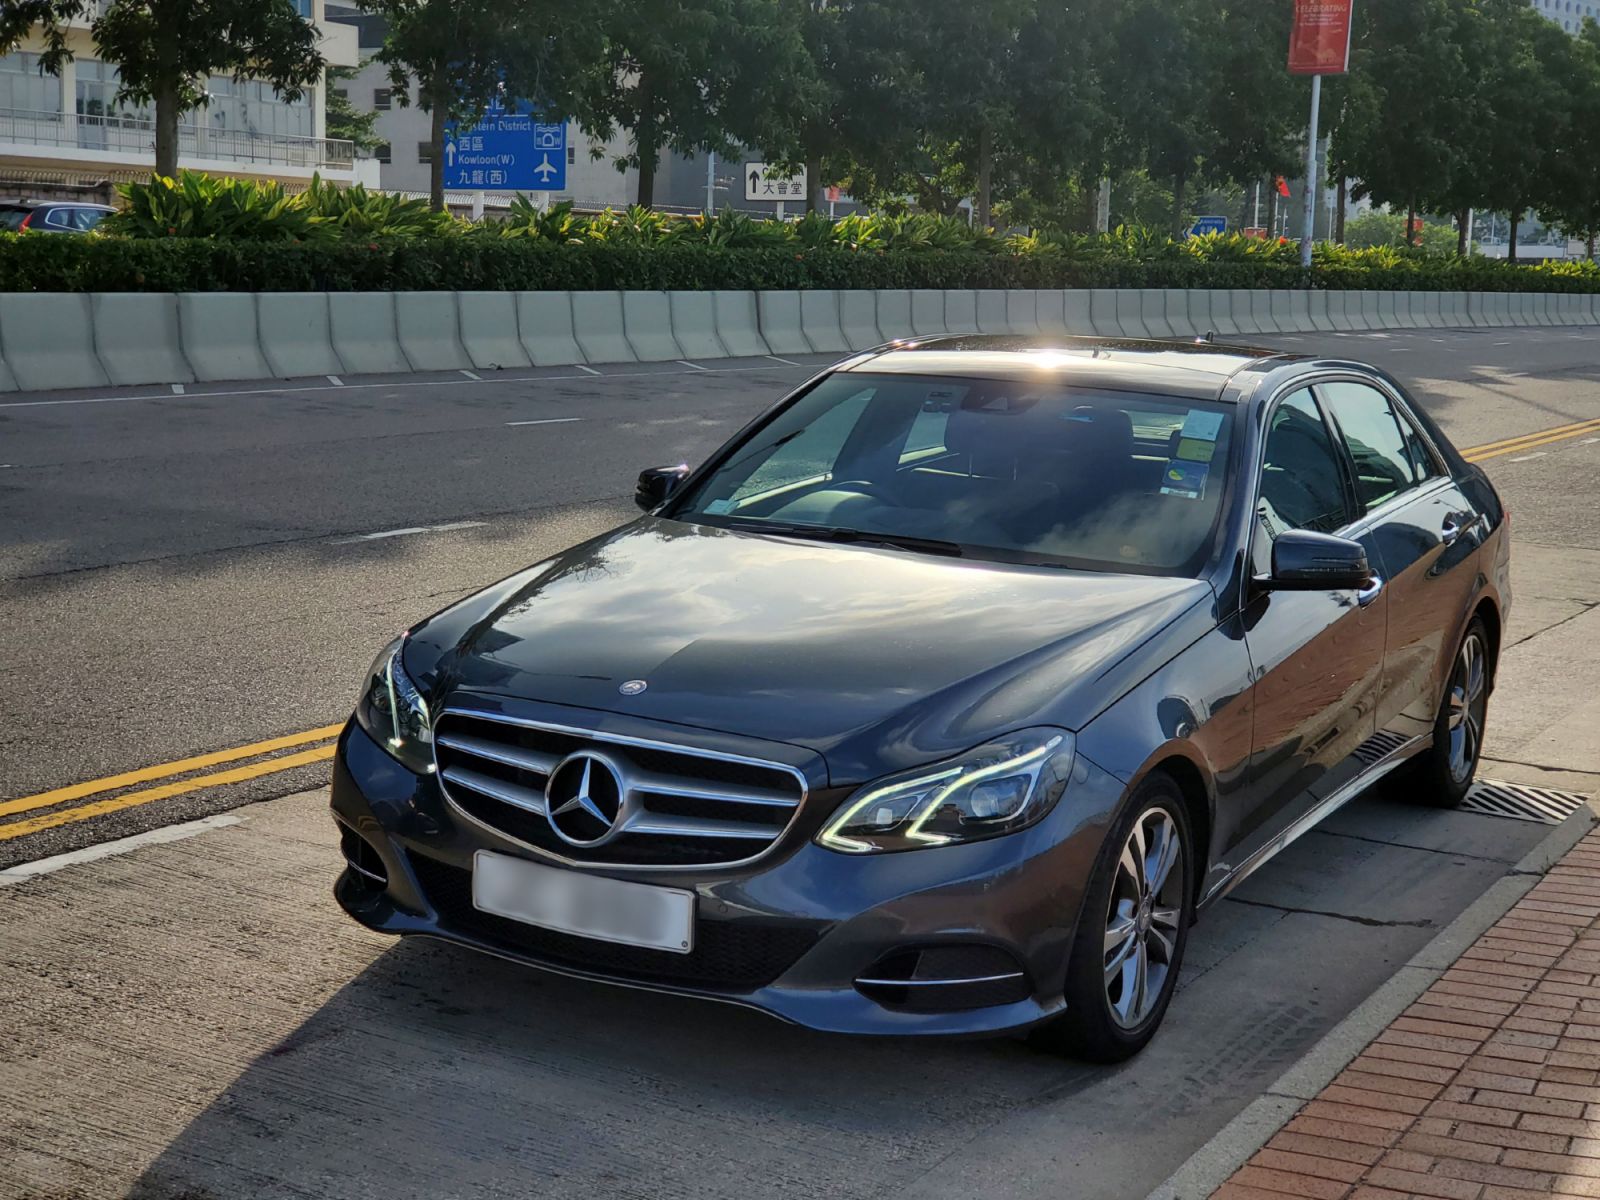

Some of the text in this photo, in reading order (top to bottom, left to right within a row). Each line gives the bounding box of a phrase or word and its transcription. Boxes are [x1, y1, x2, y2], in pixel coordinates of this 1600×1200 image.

[498, 120, 531, 131] District
[459, 136, 484, 151] 西區
[458, 154, 515, 166] Kowloon(W)
[459, 168, 508, 185] 九龍(西)
[762, 181, 802, 195] 大會堂
